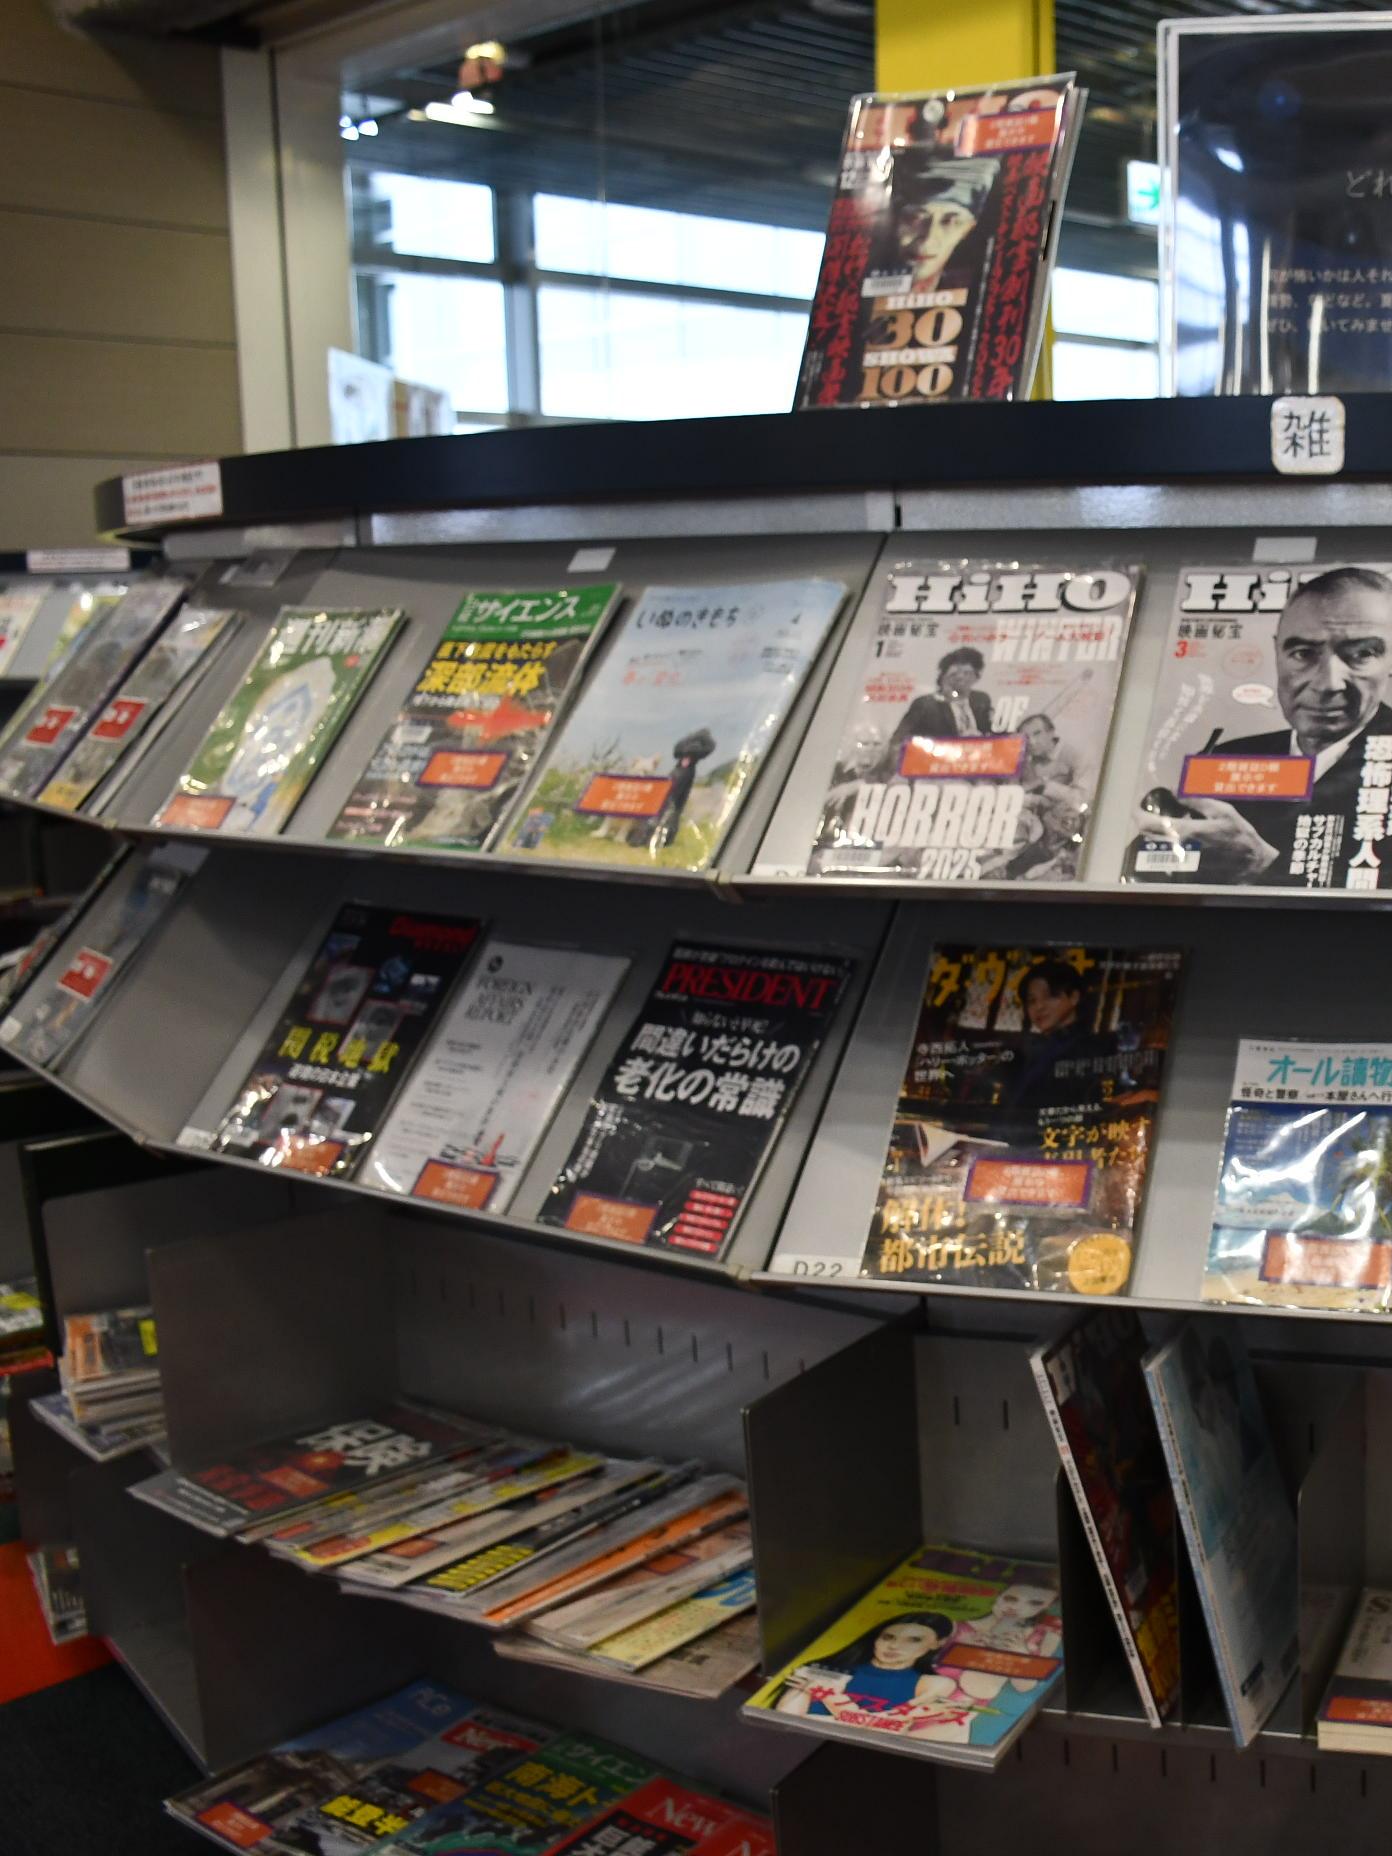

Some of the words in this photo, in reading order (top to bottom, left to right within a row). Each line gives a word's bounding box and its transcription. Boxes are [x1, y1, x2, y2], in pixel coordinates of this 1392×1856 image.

[858, 364, 954, 400] 100
[474, 595, 581, 624] サイエンス
[1174, 639, 1189, 659] 3
[991, 696, 1030, 733] OF
[850, 783, 1026, 849] HORROR
[916, 848, 983, 880] 2025
[661, 961, 840, 1010] PRESIDENT
[629, 1022, 801, 1074] 間違いだらけの
[613, 1055, 787, 1121] 老化の常識
